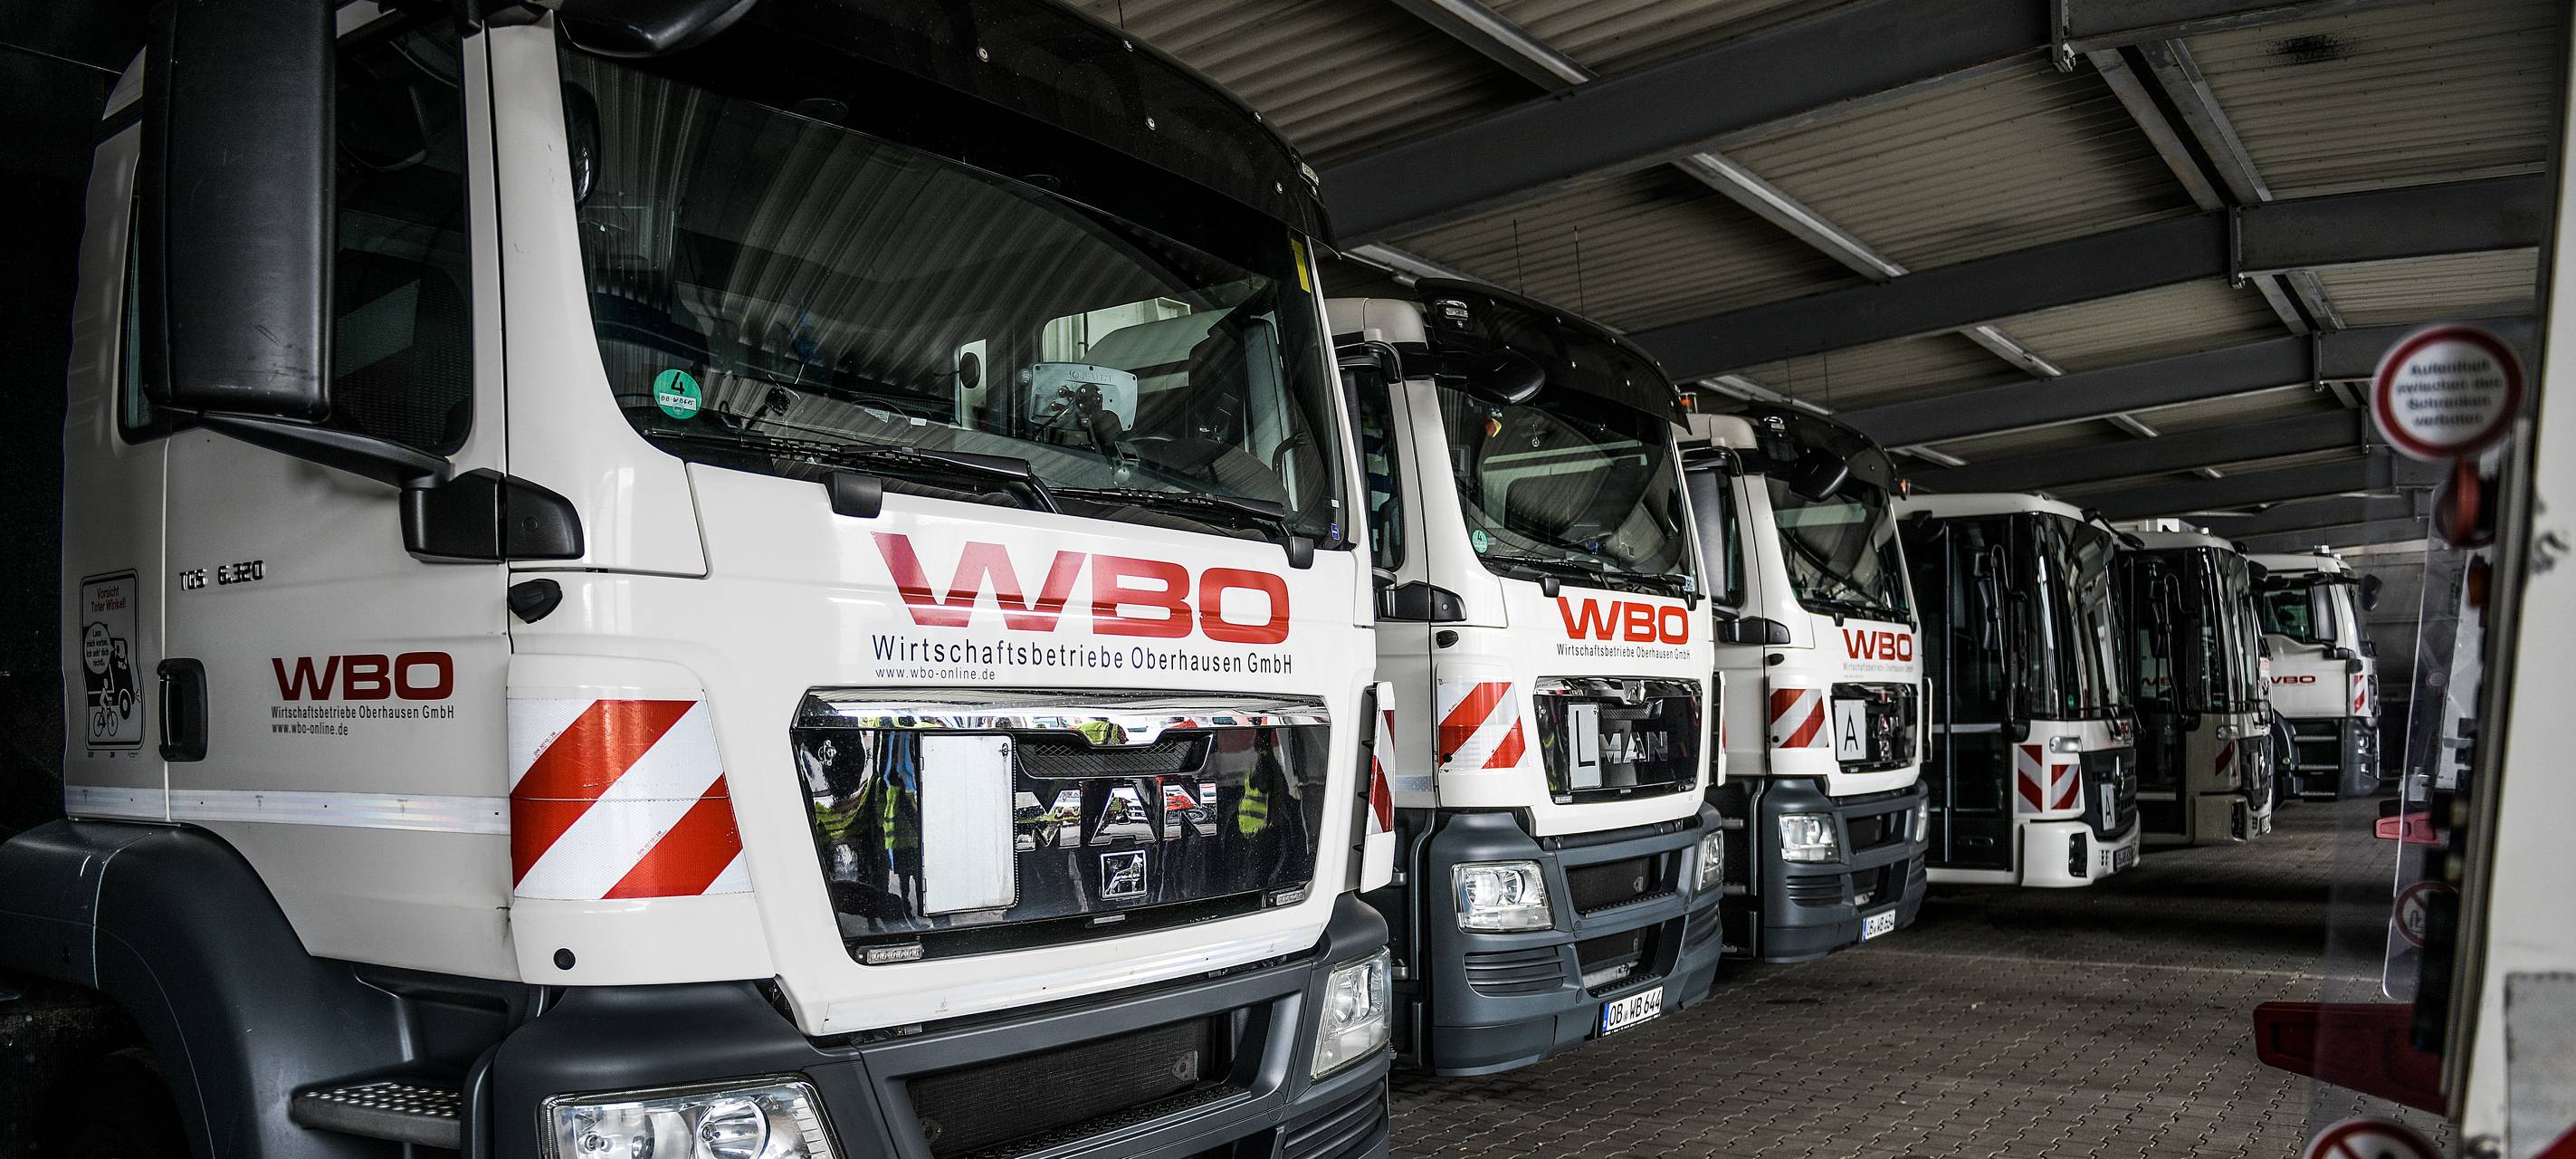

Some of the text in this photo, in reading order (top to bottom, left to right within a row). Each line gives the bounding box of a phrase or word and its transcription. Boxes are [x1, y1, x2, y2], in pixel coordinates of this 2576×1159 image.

[671, 371, 685, 395] 4
[1477, 531, 1483, 541] 4
[179, 569, 208, 591] TGS
[870, 531, 1291, 645] WBO
[1556, 597, 1689, 646] WBO
[872, 635, 1293, 675] Wirtschaftsbetriebe Oberhausen GmbH
[1557, 643, 1691, 660] Wirtschaftsbetriebe Oberhausen GmbH
[1842, 628, 1913, 662] WBO
[272, 651, 453, 701] WBO
[875, 666, 996, 681] www.wbo-online.de
[272, 704, 454, 719] Wirtschaftsbetriebe Oberhausen GmbH
[272, 723, 348, 736] www.wbo-online.de
[1575, 710, 1597, 768] L
[1844, 708, 1859, 752] A
[1599, 731, 1668, 764] MAN
[1016, 782, 1217, 853] MAN
[2105, 790, 2113, 823] A
[1608, 990, 1662, 1026] OB WB 644
